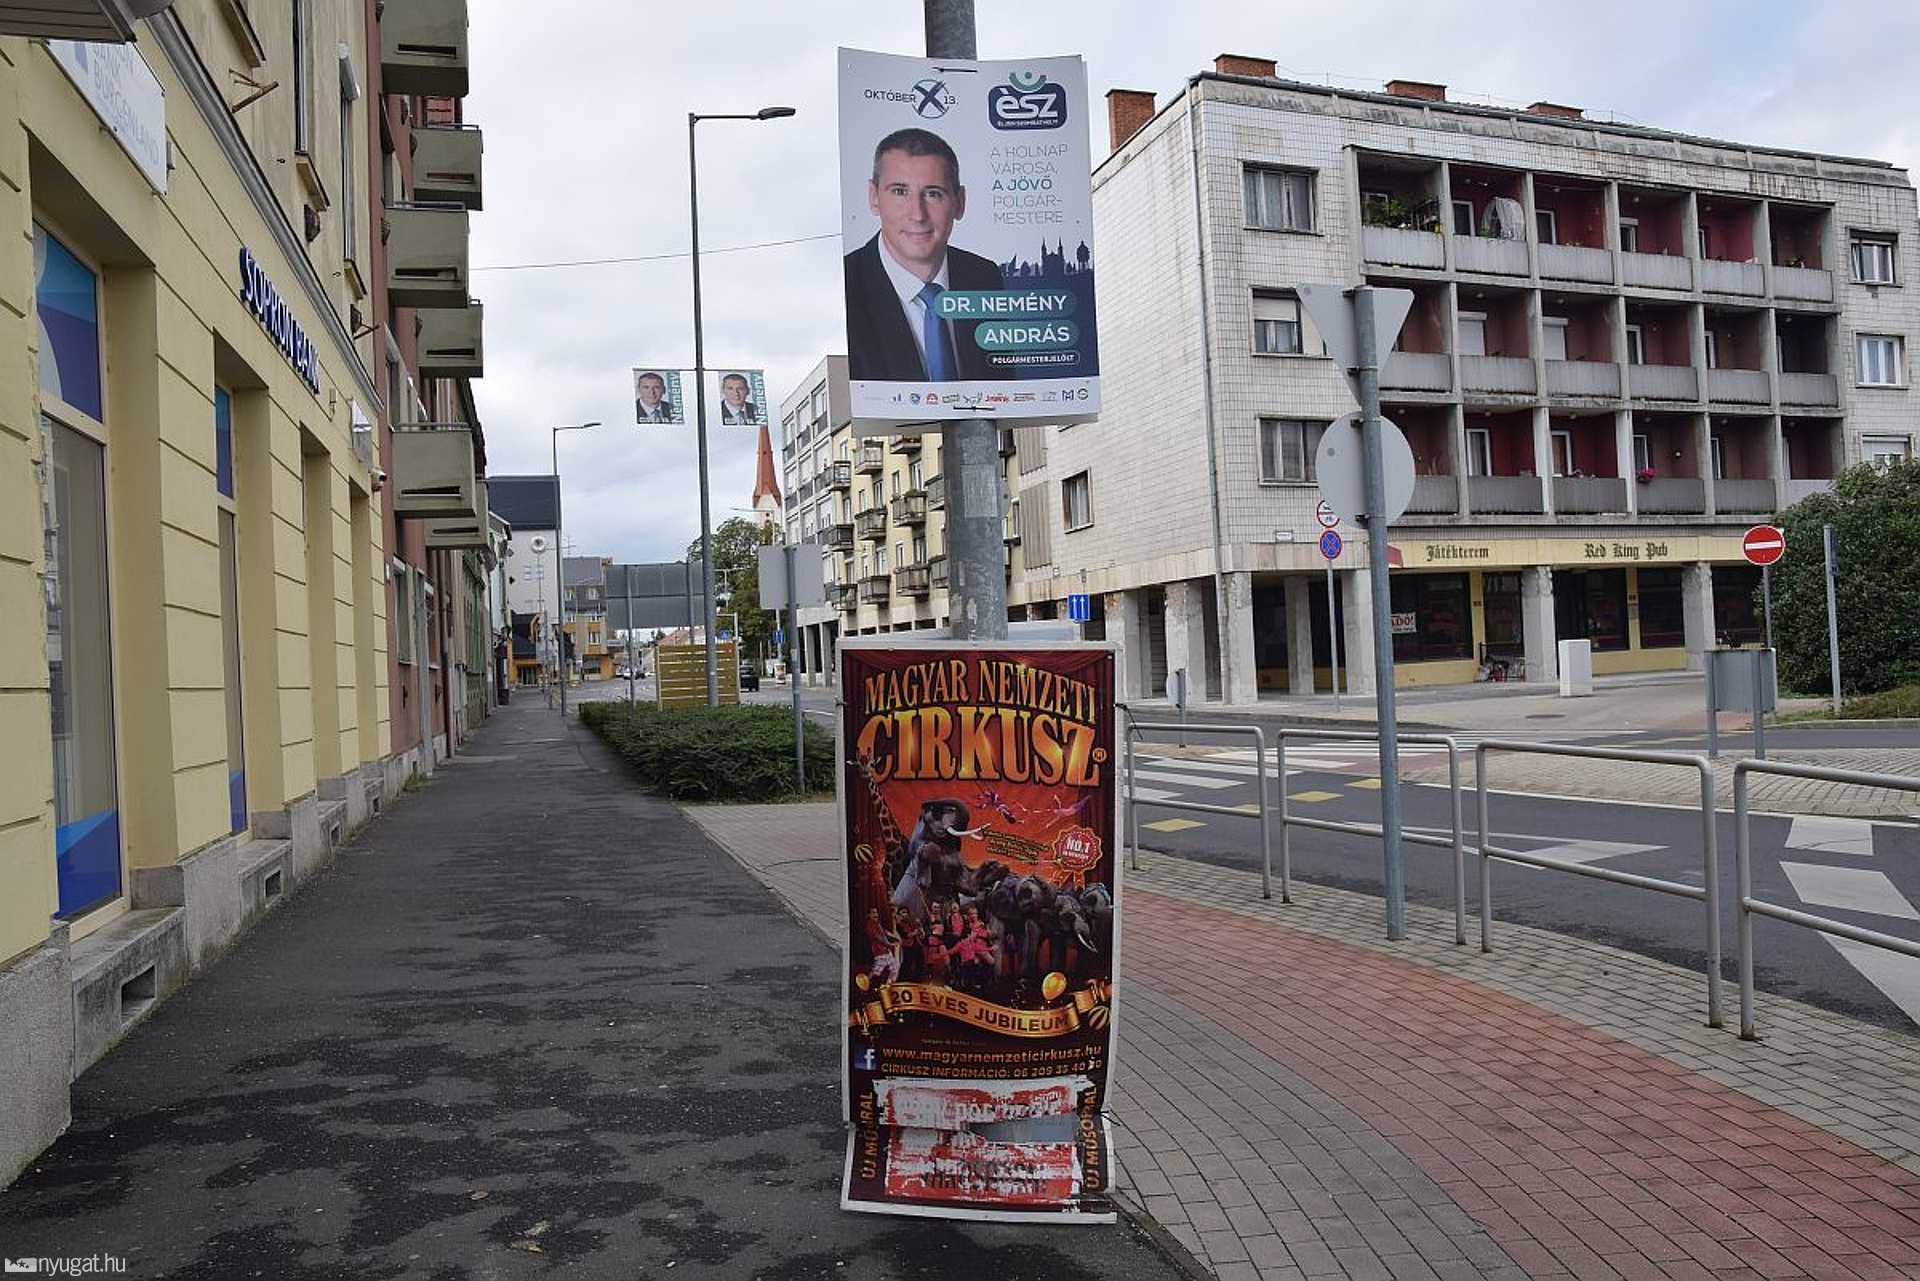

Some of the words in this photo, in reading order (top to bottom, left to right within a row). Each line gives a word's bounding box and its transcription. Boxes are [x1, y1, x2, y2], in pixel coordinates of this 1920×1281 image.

[864, 88, 916, 103] OKTÓBER
[991, 147, 1000, 159] A
[1006, 143, 1068, 158] HOLNAP
[992, 179, 1004, 191] A
[993, 210, 1064, 225] MESTERE
[240, 247, 294, 359] SOPRON
[943, 296, 975, 312] DR.
[981, 292, 1067, 312] NEMÉNY
[983, 324, 1070, 344] ANDRÁS
[1584, 543, 1606, 558] Red
[1613, 543, 1639, 560] King
[1646, 541, 1668, 560] Pub
[864, 659, 969, 716] MAGYAR
[979, 659, 1096, 724] NEMZETI
[856, 706, 1099, 787] CIRKUSZ
[974, 1007, 1069, 1032] JUBILEUM
[882, 1044, 1102, 1064] www.magyarnemzeticirkusz.hu
[881, 1063, 929, 1074] CIRKUSZ
